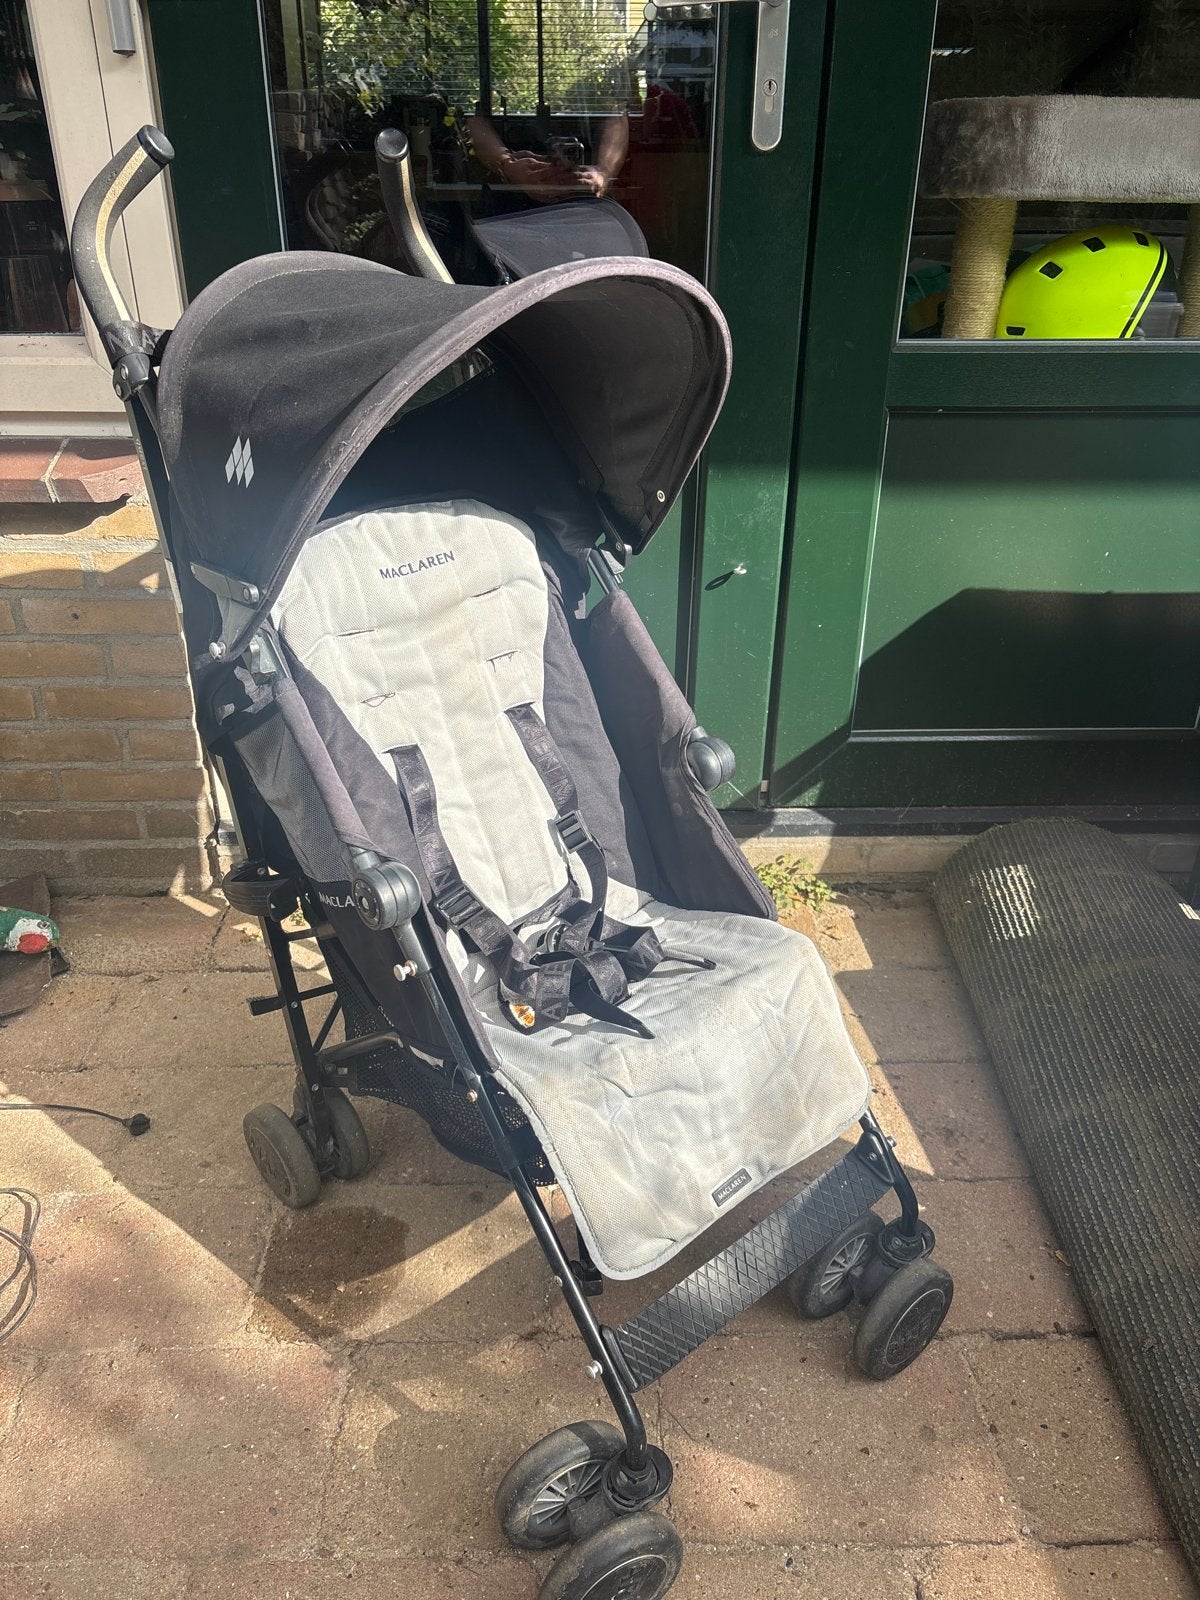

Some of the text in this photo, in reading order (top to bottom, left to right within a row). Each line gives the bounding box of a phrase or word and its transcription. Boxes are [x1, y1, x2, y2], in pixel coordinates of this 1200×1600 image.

[379, 550, 455, 580] MACLAREN
[318, 891, 356, 908] MACLA
[717, 1174, 748, 1201] MACLAREN
